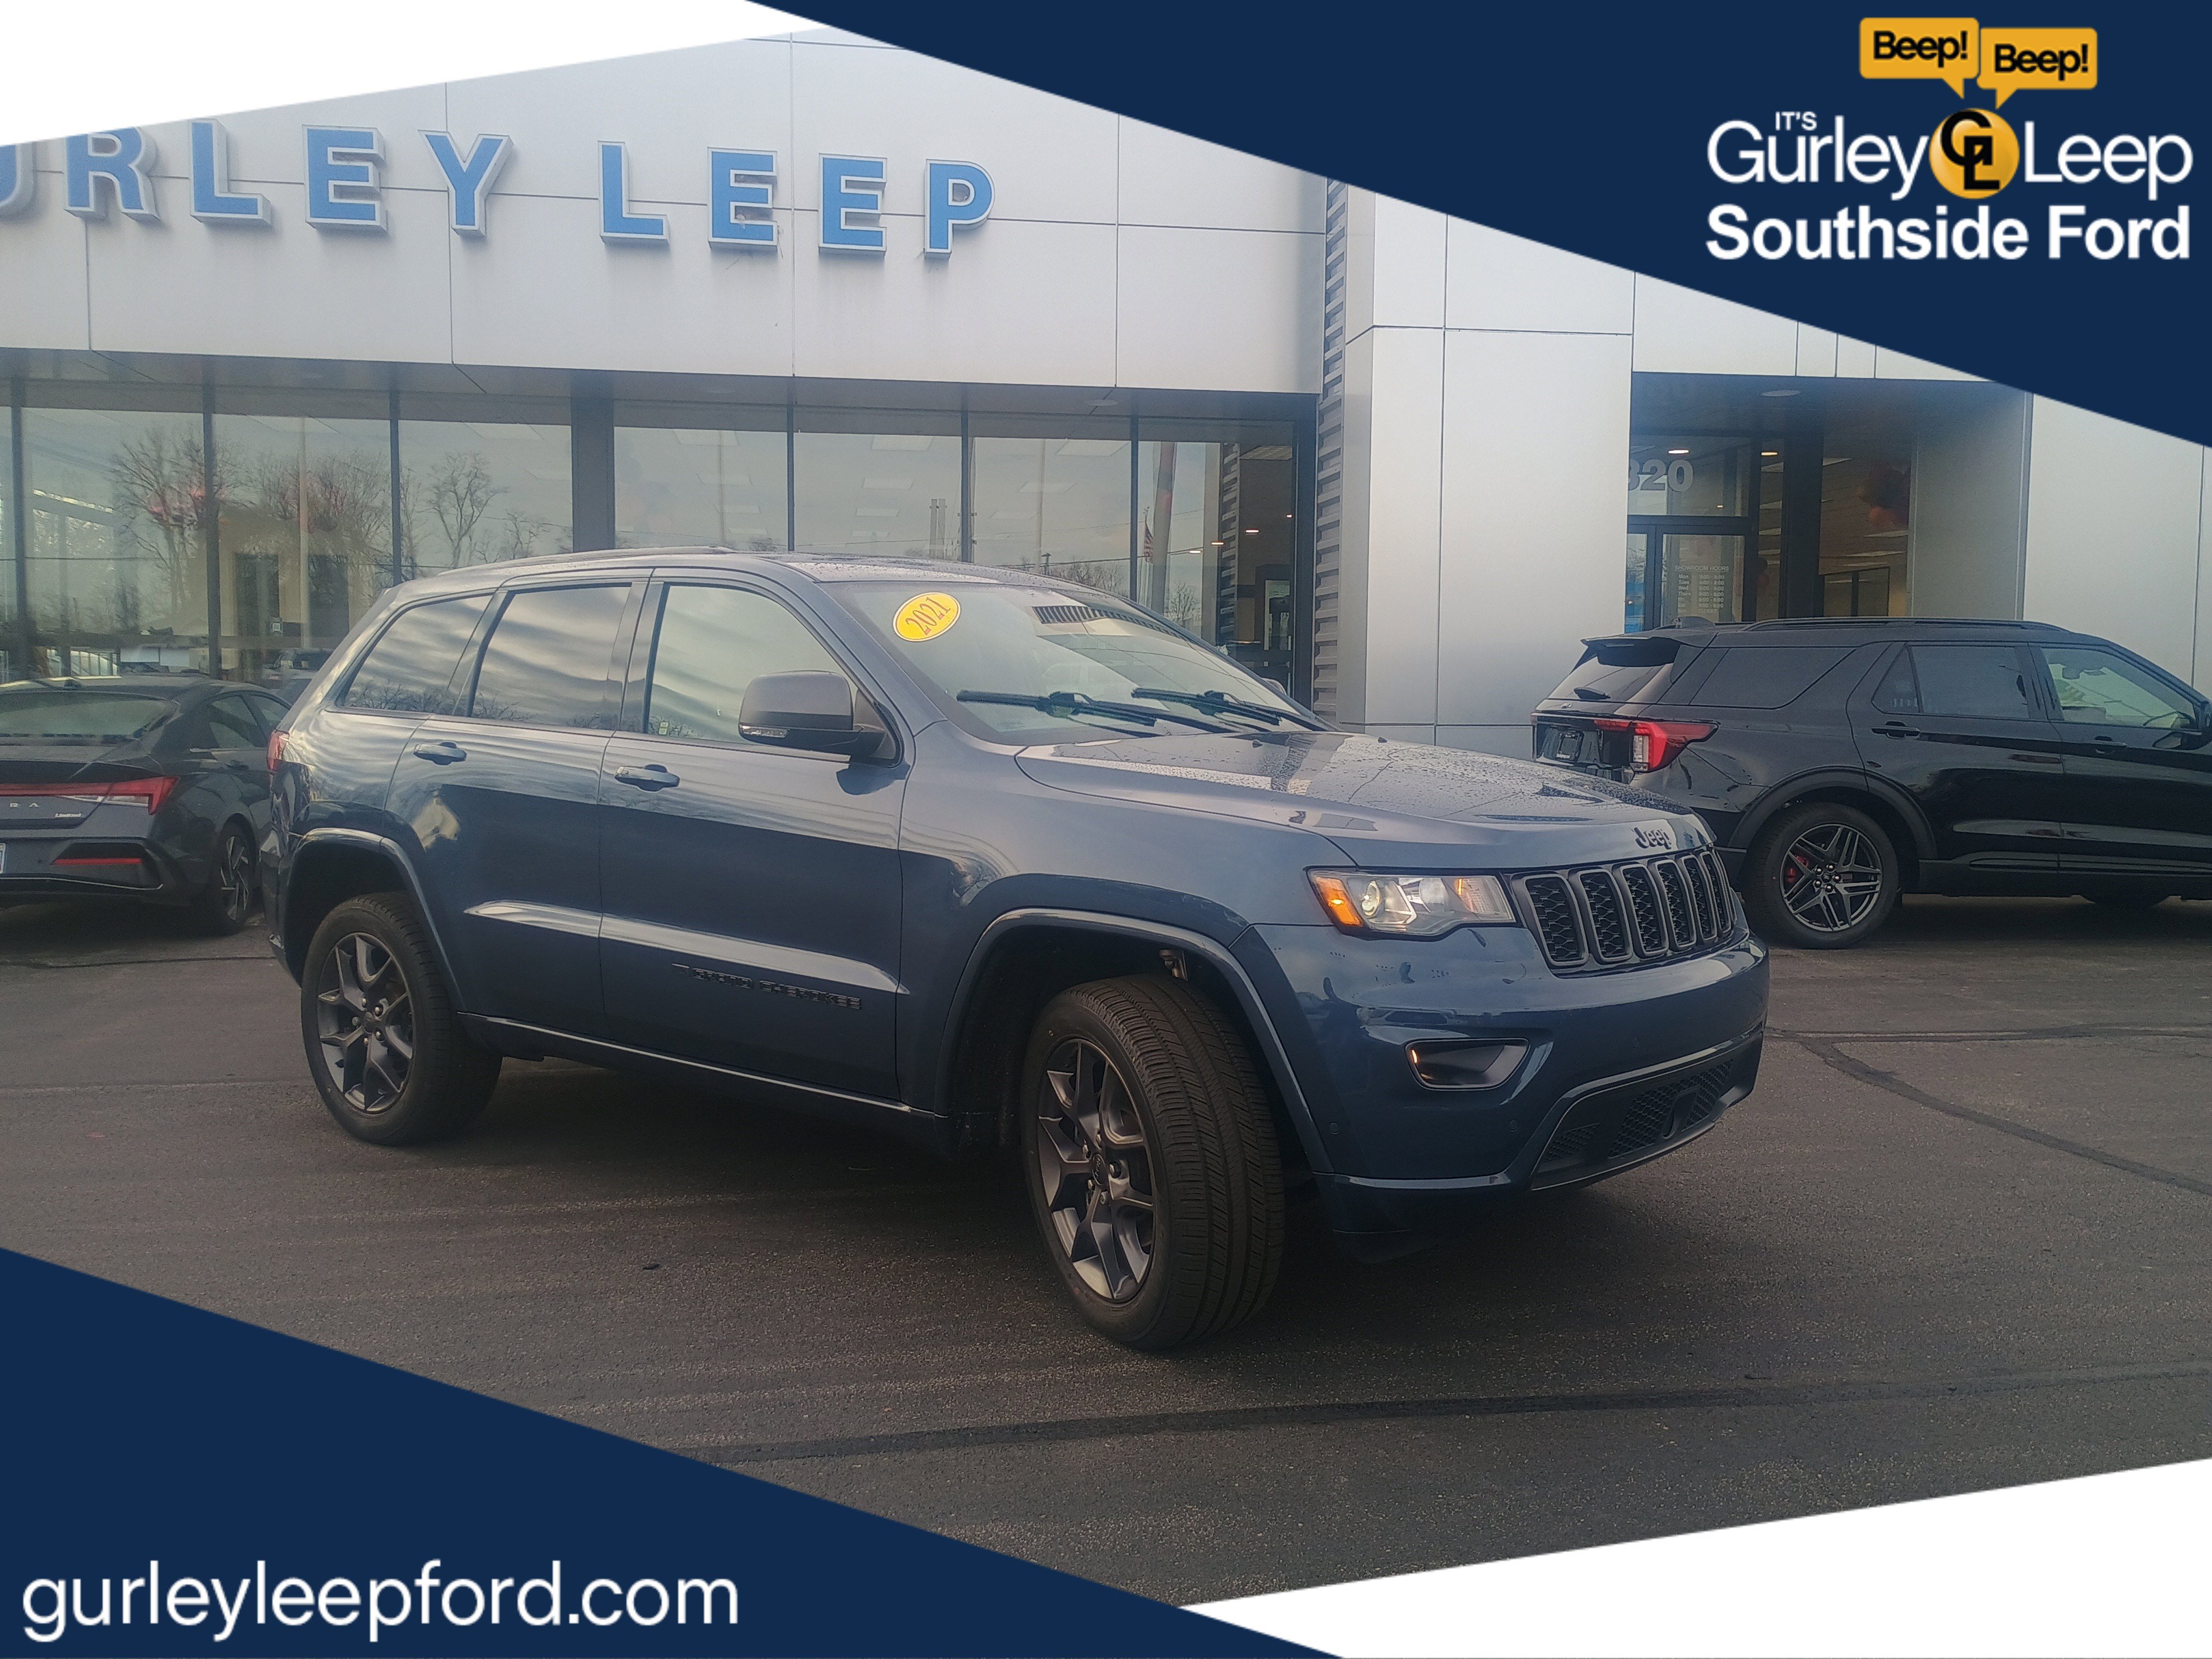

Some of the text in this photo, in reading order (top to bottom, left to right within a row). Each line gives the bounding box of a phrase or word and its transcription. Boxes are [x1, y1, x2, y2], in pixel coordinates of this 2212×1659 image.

[597, 140, 995, 259] LEEP
[905, 597, 952, 635] 2021
[1633, 827, 1672, 850] Jeep
